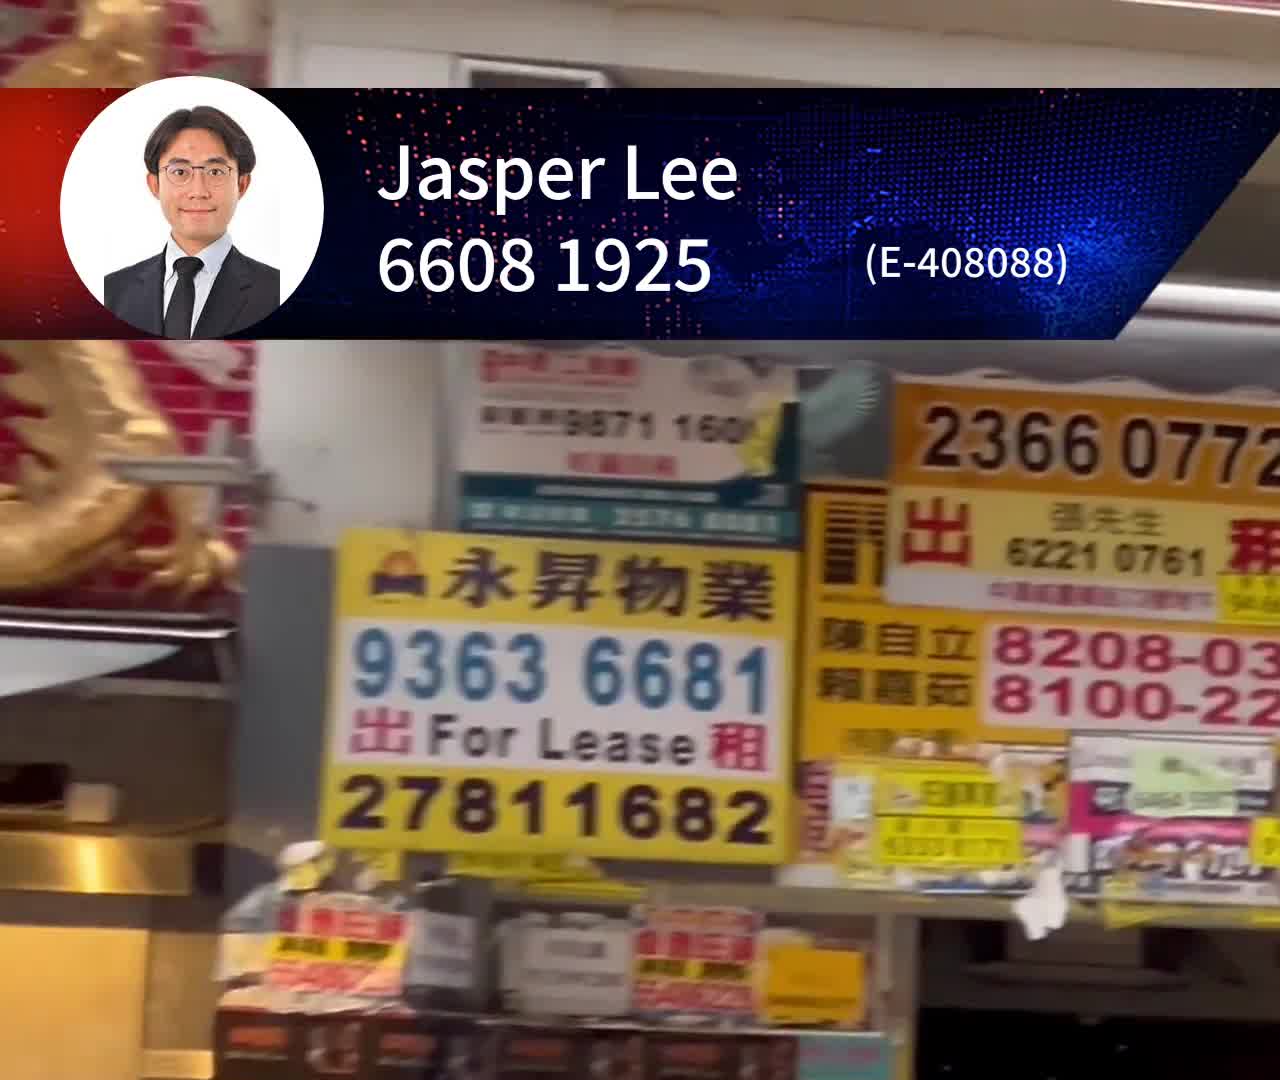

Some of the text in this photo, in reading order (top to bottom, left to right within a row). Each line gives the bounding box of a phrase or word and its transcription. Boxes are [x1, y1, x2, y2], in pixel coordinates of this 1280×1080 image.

[921, 405, 1100, 477] 2366
[902, 496, 971, 567] 出
[1006, 537, 1098, 572] 6221
[353, 628, 769, 714] 9363 6681
[349, 707, 769, 772] 出 For Lease 租
[337, 773, 774, 847] 27811682
